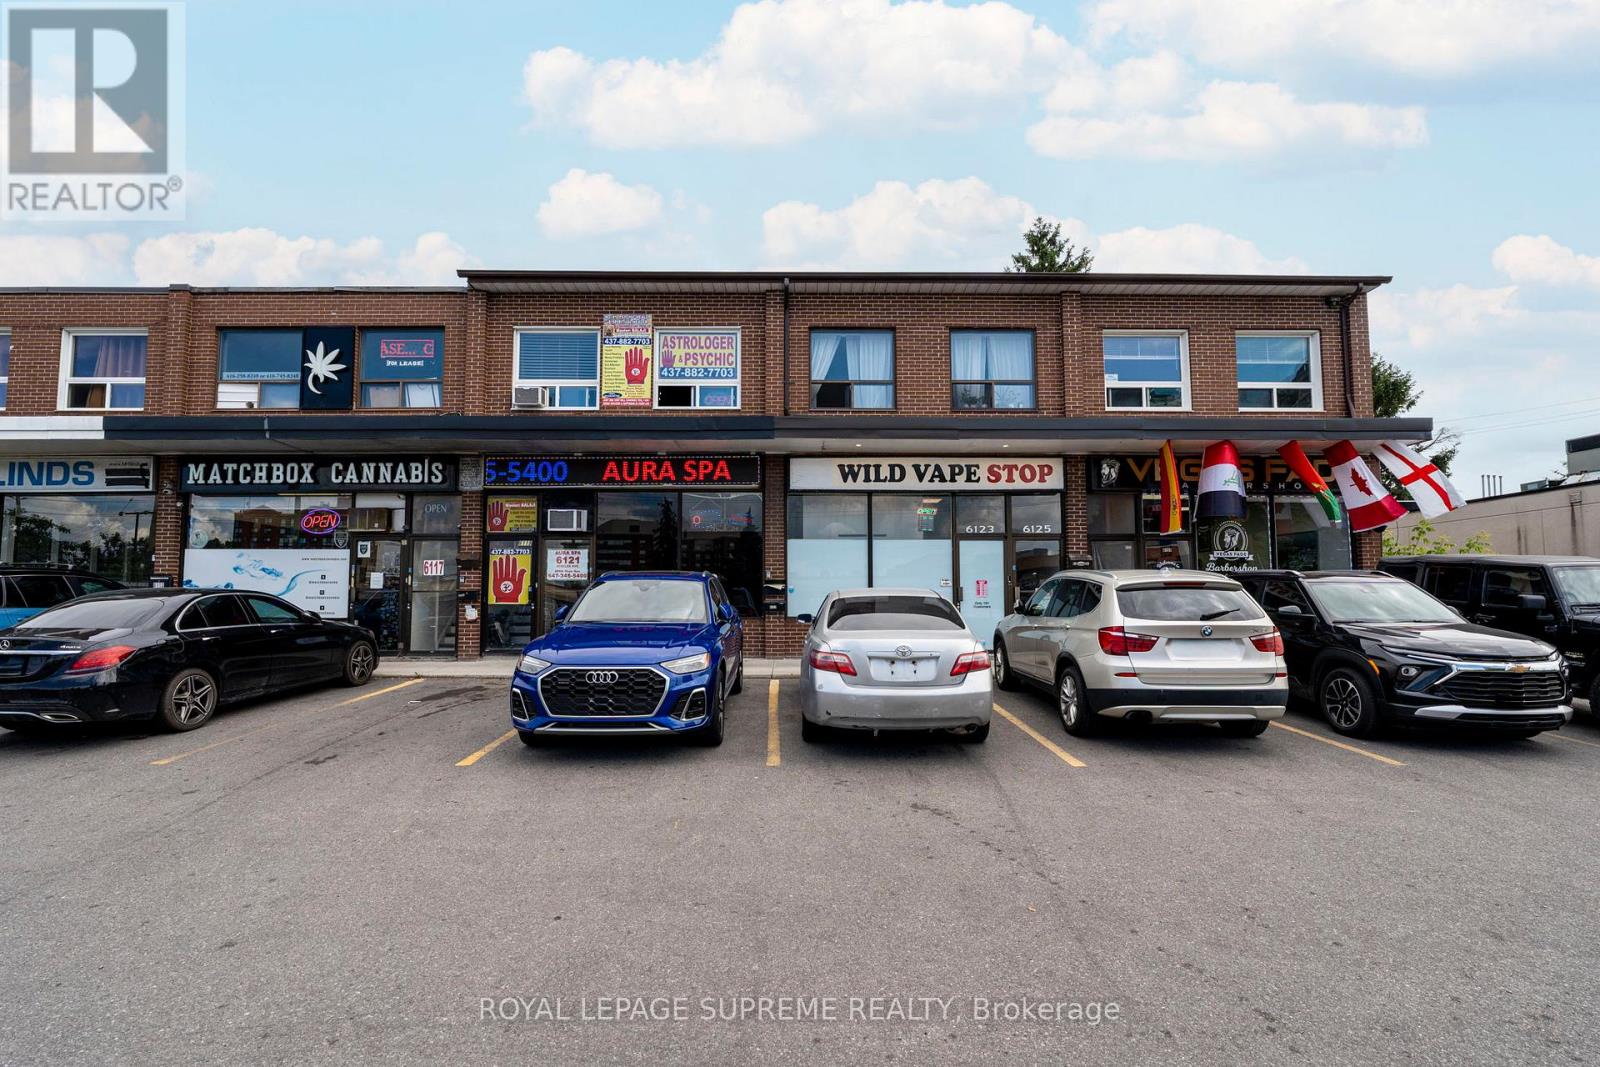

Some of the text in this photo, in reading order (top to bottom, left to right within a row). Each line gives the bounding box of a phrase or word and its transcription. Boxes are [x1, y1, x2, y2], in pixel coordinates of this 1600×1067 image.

[662, 336, 734, 349] ASTROLOGER
[684, 352, 734, 366] PSYCHIC
[661, 367, 734, 378] 437-882-7703
[0, 461, 95, 487] INDS
[187, 463, 314, 484] MATCHBOX
[331, 459, 443, 484] CANNABIS
[602, 461, 676, 482] AURA
[683, 460, 732, 482] SPA
[837, 464, 1053, 483] WILD VAPE STOP
[424, 504, 447, 513] OPEN
[303, 511, 338, 528] OPEN
[965, 525, 994, 534] 6123
[1023, 525, 1051, 534] 6125
[556, 556, 580, 564] 6121
[424, 560, 445, 576] 6117
